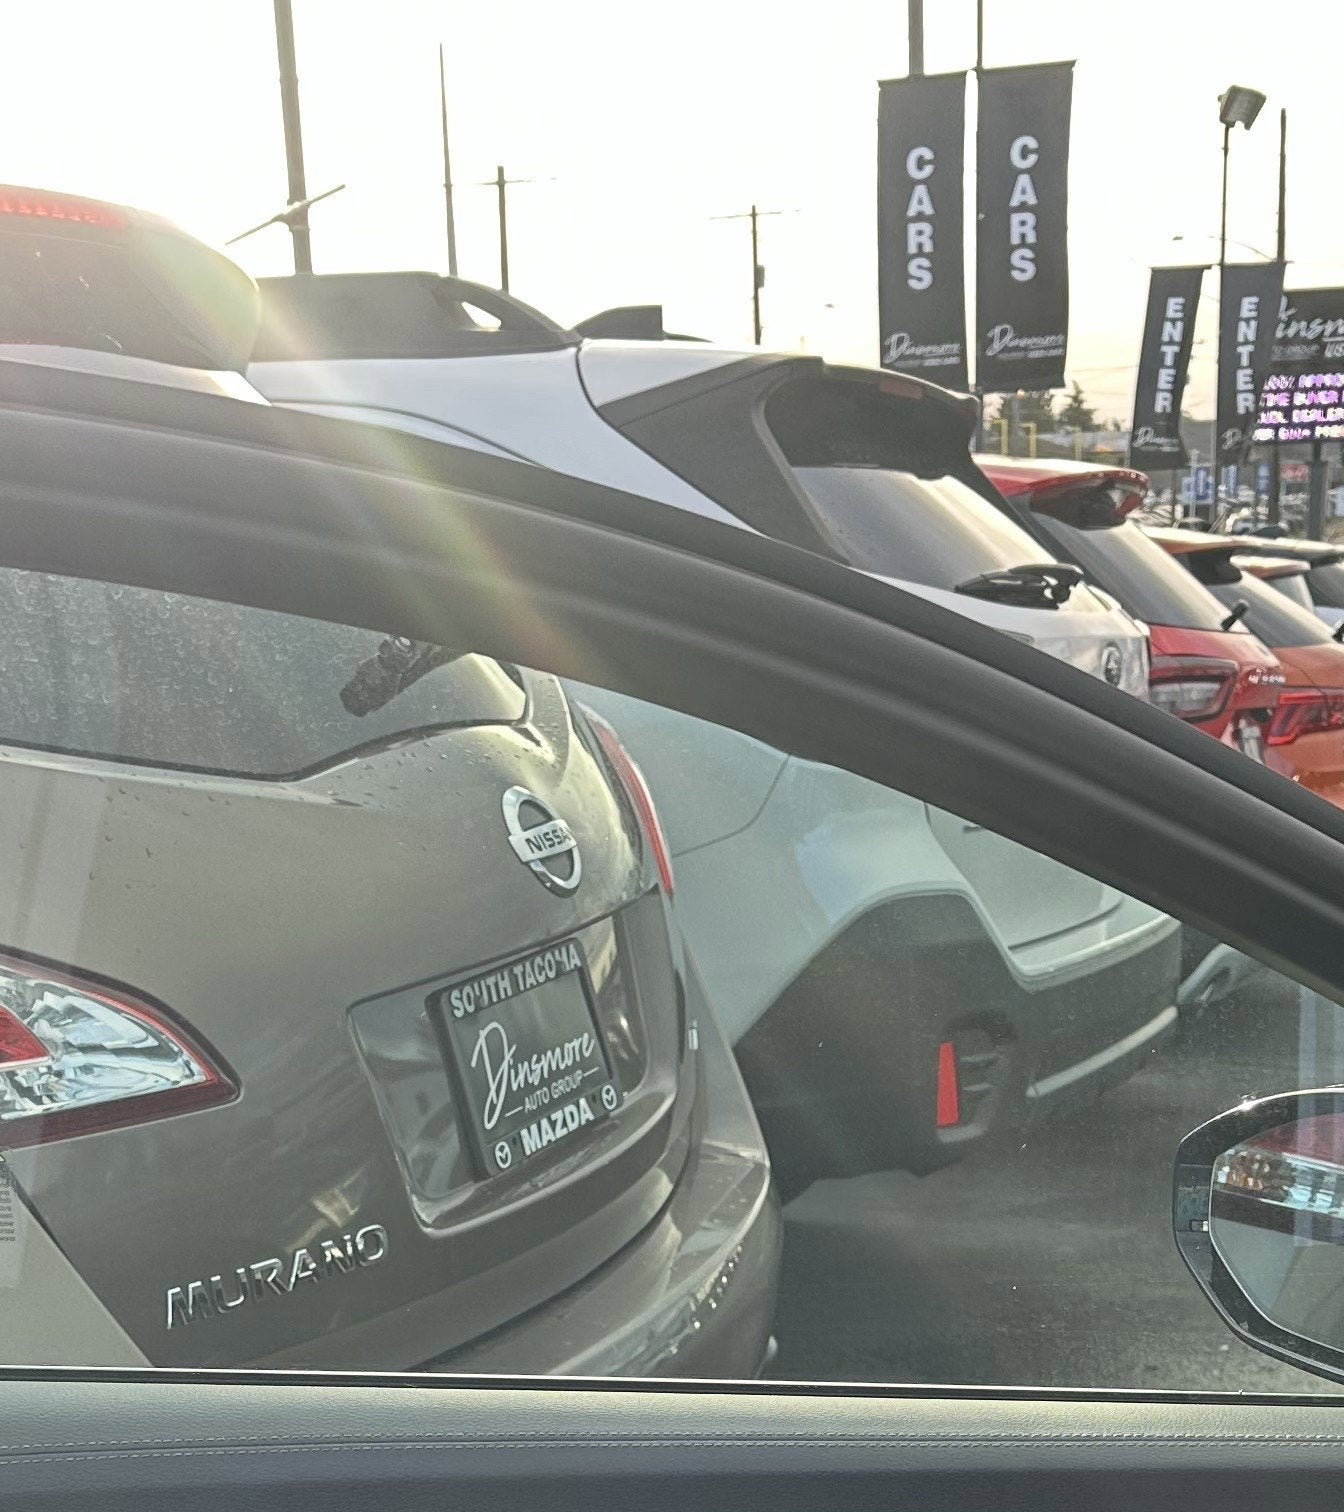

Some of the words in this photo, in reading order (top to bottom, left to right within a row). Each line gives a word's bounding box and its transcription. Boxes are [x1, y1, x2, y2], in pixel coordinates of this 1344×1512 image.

[906, 146, 936, 290] CARS
[1008, 135, 1040, 282] CARS
[1154, 296, 1186, 414] ENTER
[1236, 295, 1260, 415] ENTER
[523, 825, 573, 854] NISSA
[449, 971, 513, 1018] SOUTH
[513, 944, 582, 993] TACOMA
[470, 1020, 596, 1130] Dinsmore
[519, 1096, 595, 1156] MAZDA
[524, 1086, 550, 1114] AUTO
[550, 1069, 584, 1100] GROUP
[165, 1222, 390, 1331] MURANO
